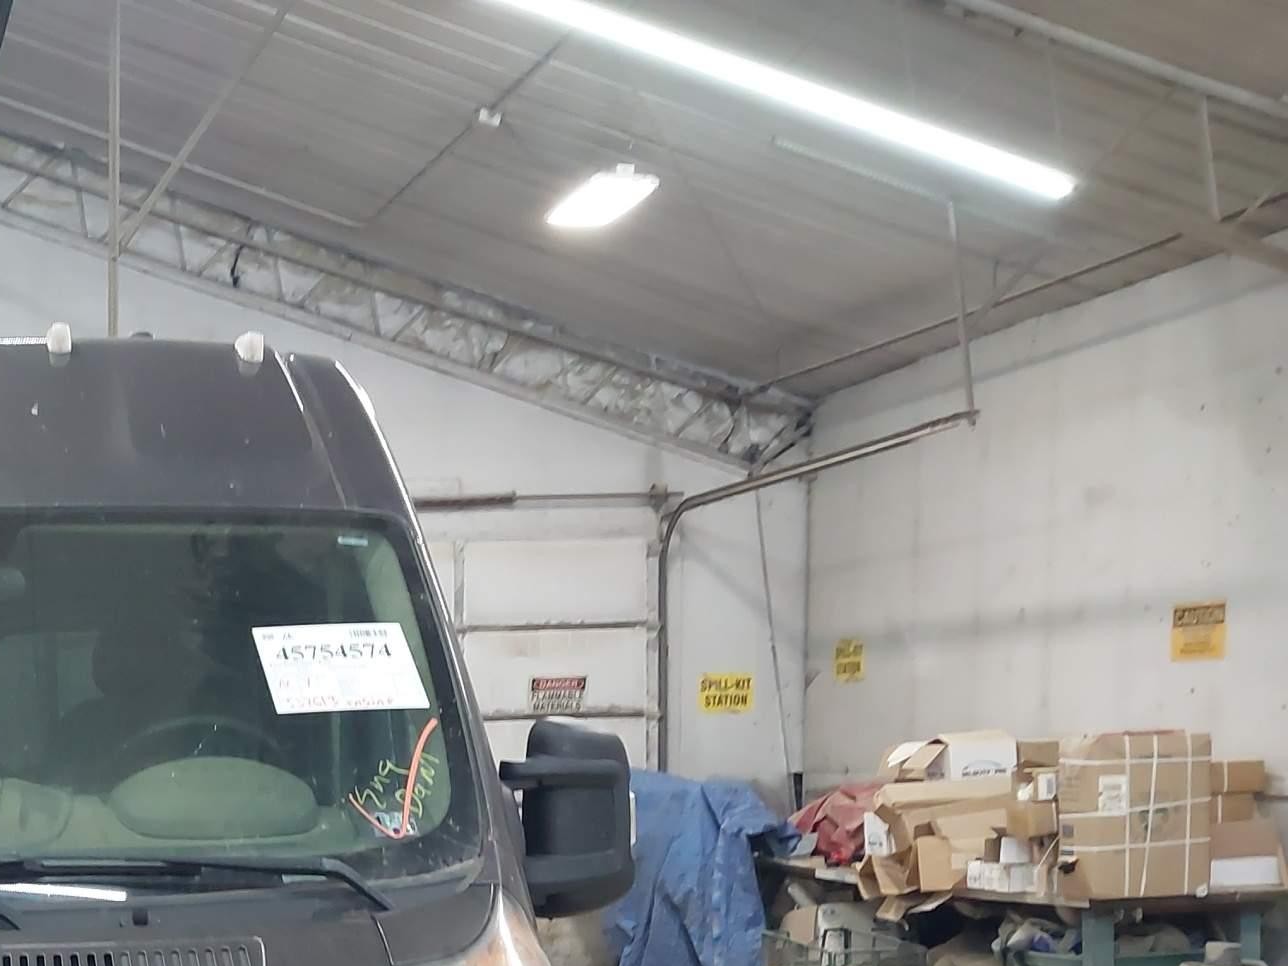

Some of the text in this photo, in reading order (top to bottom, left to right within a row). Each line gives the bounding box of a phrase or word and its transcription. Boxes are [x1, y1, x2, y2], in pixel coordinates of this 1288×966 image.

[276, 643, 392, 661] 45754574
[700, 677, 752, 692] SPILL-KIT
[704, 694, 748, 708] STATION
